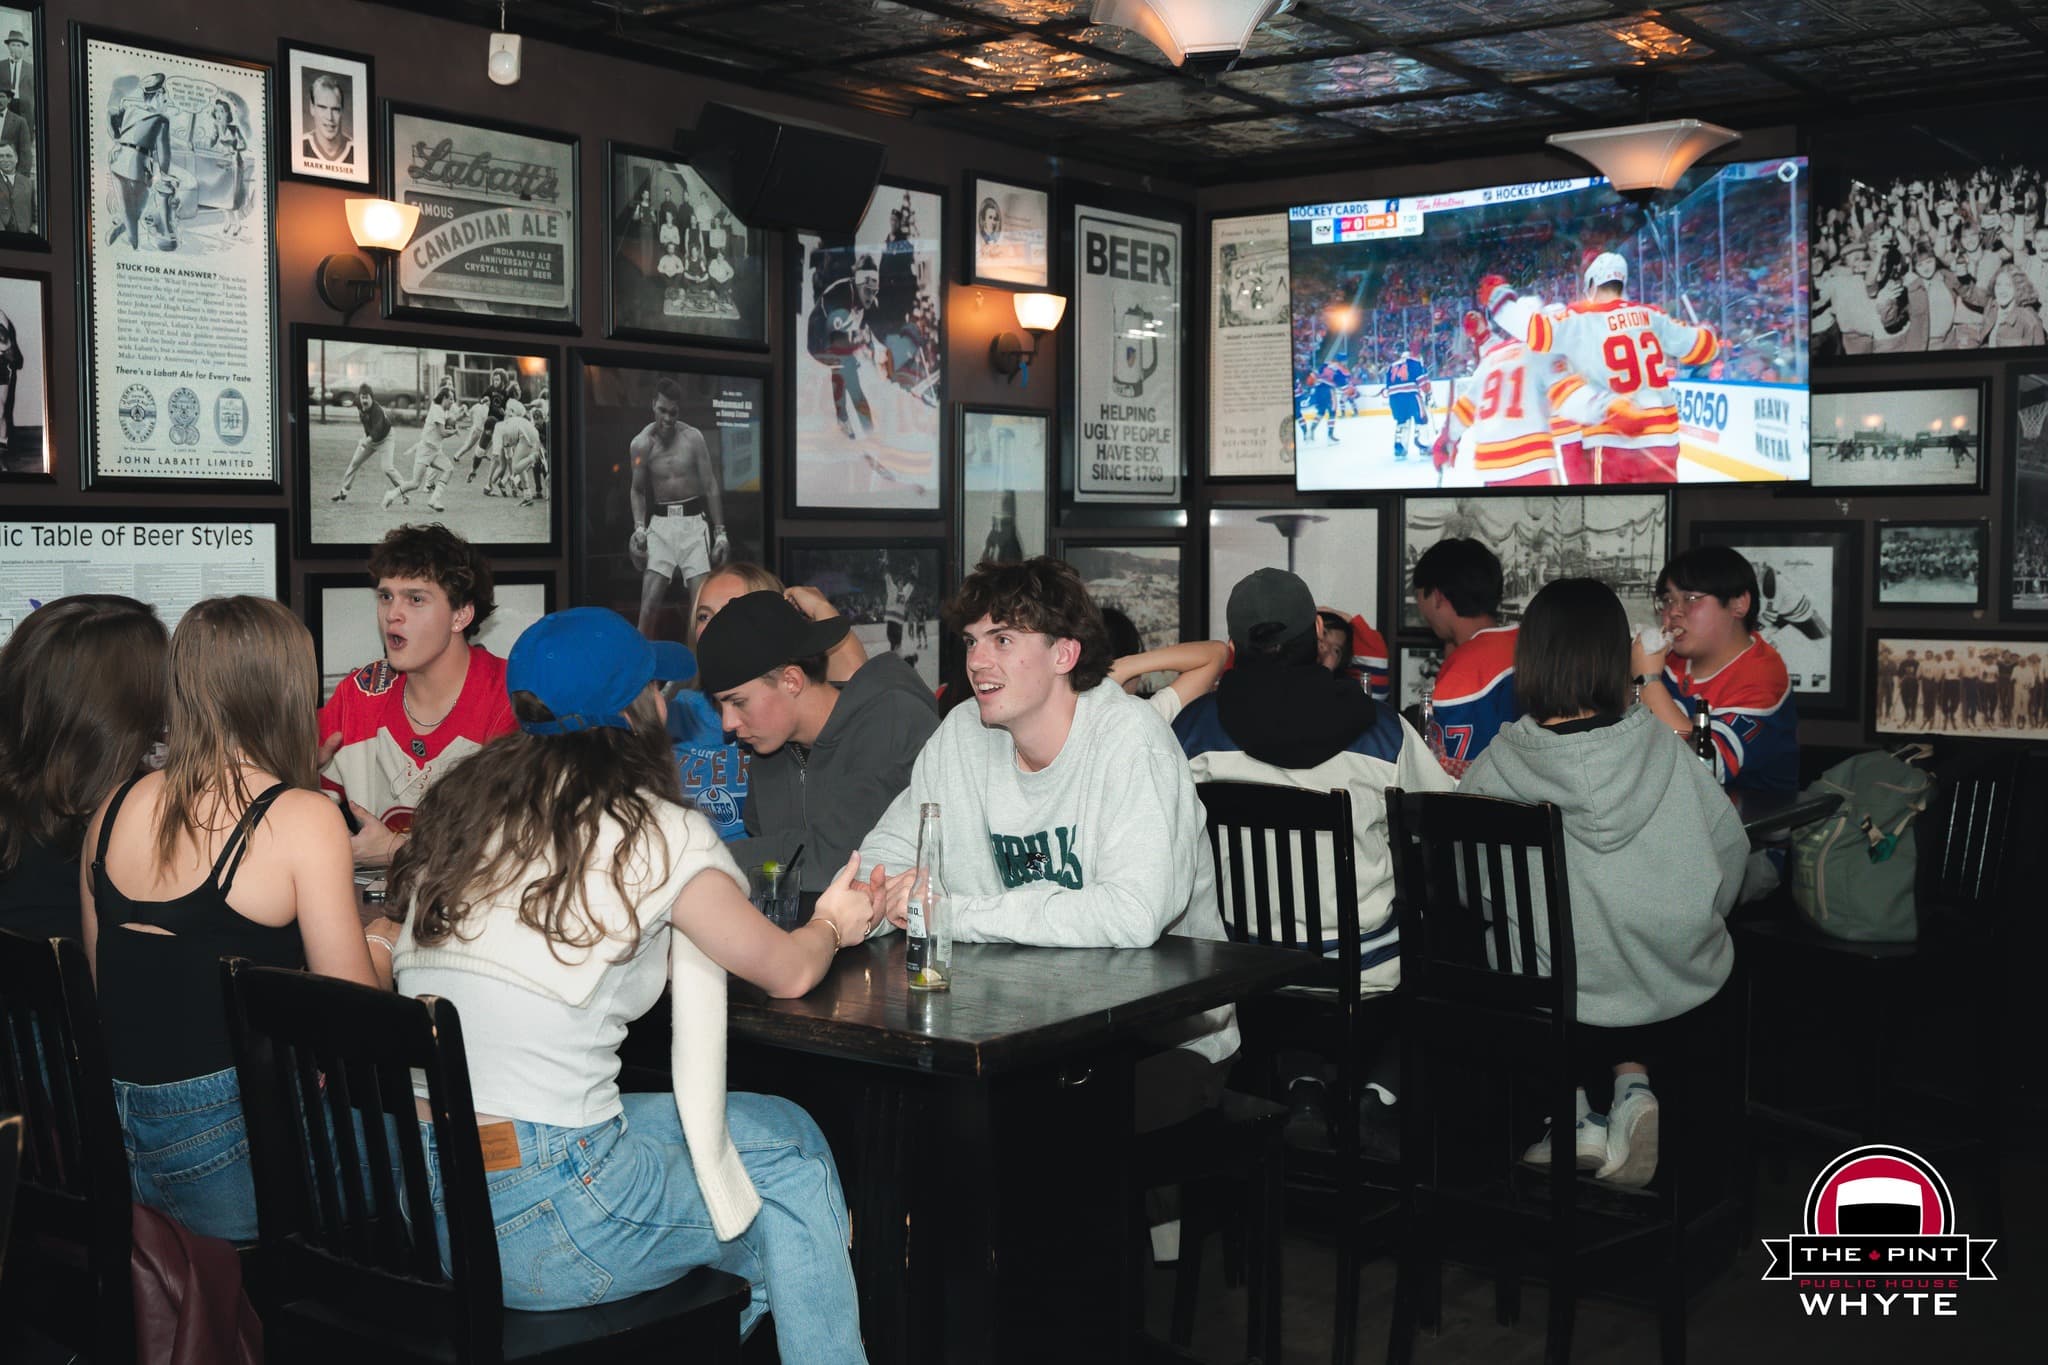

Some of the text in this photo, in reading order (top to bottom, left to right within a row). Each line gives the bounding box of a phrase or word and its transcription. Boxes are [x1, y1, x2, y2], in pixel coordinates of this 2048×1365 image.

[304, 161, 354, 174] MARK MESSIER
[408, 138, 560, 198] Labatt's
[1496, 180, 1572, 200] HOCKEY CARDS
[1292, 204, 1369, 217] HOCKEY CARDS
[413, 213, 557, 269] CANADIAN ALE
[480, 255, 550, 271] ANNIVERSARY ALE
[493, 247, 552, 261] INDIA PALE ALE
[1086, 231, 1171, 287] BEER
[116, 262, 142, 272] STUCK
[145, 265, 160, 274] FOR
[163, 267, 175, 275] AN
[178, 268, 217, 280] ANSWER?
[464, 262, 552, 280] CRYSTAL LAGER BEER
[1608, 312, 1650, 331] GRIDIN
[1603, 331, 1669, 394] 92
[116, 366, 144, 376] There's
[154, 369, 178, 377] Labatt
[196, 371, 206, 379] for
[209, 372, 229, 382] Every
[232, 374, 251, 382] Taste
[1479, 366, 1527, 420] 91
[1100, 404, 1156, 423] HELPING
[1754, 398, 1790, 424] HEAVY
[1084, 423, 1171, 444] UGLY PEOPLE
[1096, 444, 1160, 462] HAVE SEX
[1755, 431, 1791, 462] METAL
[117, 456, 254, 468] JOHN LABATT LIMITED
[1092, 463, 1131, 480] SINCE
[0, 525, 254, 549] ic Table of Beer Styles
